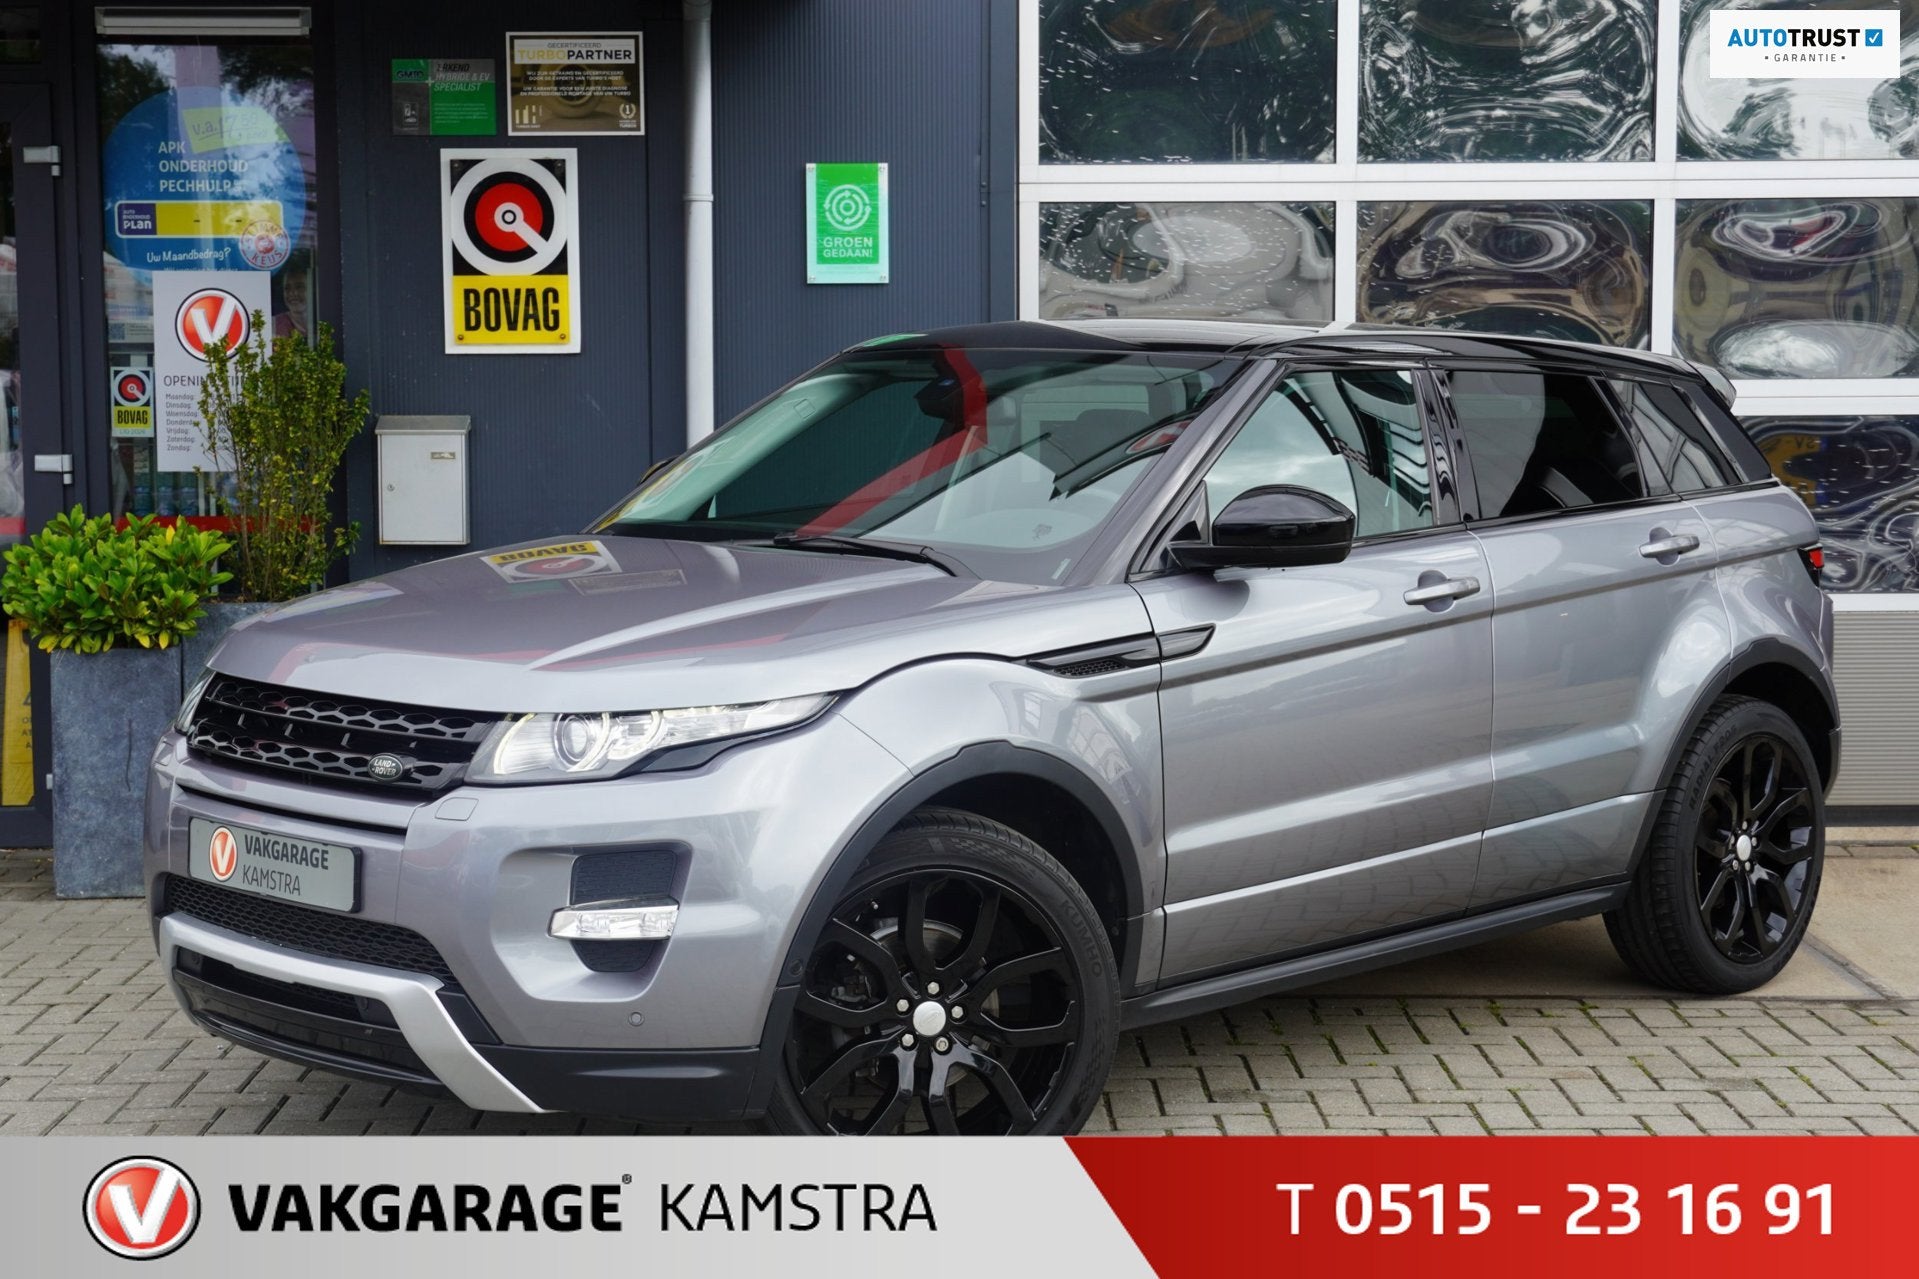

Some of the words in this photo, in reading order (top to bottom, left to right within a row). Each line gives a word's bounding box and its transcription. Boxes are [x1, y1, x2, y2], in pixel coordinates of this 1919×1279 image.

[517, 49, 632, 60] TURBOPARTNER
[434, 82, 481, 92] SPECIALIST
[158, 141, 186, 154] APK
[159, 160, 248, 173] ONDERHOUD
[160, 179, 231, 192] PECHHULP
[823, 236, 873, 248] GROEN
[147, 252, 161, 263] Uw
[162, 247, 231, 263] Maandbedrag?
[823, 248, 873, 258] GEDAAN!
[463, 286, 560, 332] BOVAG
[117, 409, 148, 425] BOVAG
[374, 759, 392, 768] LAND
[375, 766, 397, 776] ROVER
[244, 833, 329, 870] VAKGARAGE
[242, 864, 301, 896] KAMSTRA
